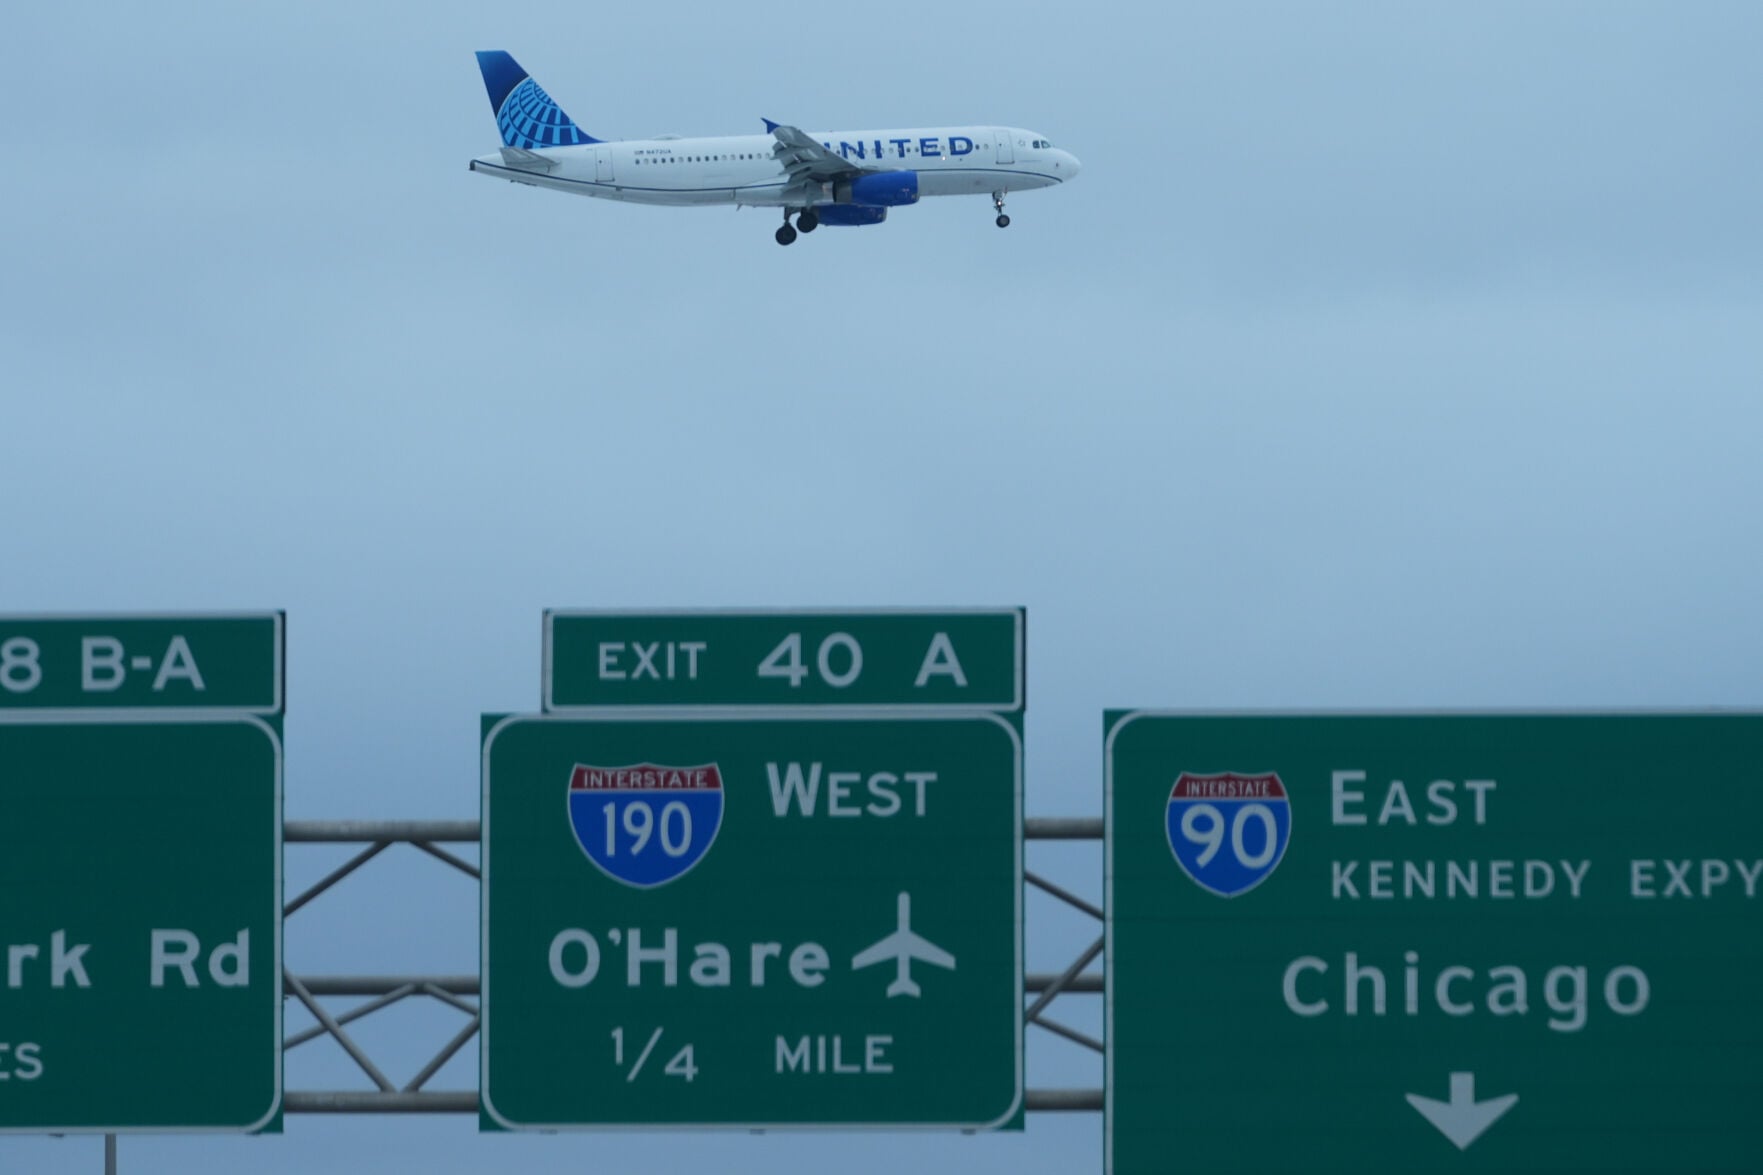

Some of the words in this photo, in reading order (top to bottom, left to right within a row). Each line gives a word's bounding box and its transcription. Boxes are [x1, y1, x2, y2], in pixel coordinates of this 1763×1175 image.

[823, 137, 973, 159] NITED
[0, 636, 42, 692] 8
[81, 635, 206, 691] B-A
[598, 641, 707, 679] EXIT
[757, 632, 863, 687] 40
[914, 632, 968, 687] A
[583, 769, 709, 788] INTERSTATE
[1186, 780, 1270, 797] INTERSTATE
[602, 800, 693, 857] 190
[1180, 803, 1279, 869] 90
[1332, 860, 1591, 899] KENNEDY
[1631, 859, 1763, 898] EXPY
[8, 929, 91, 988] rk
[150, 927, 250, 988] Rd
[548, 927, 830, 988] O'Hare
[1282, 950, 1650, 1032] Chicago
[611, 1027, 699, 1082] 1/4
[775, 1035, 894, 1073] MILE
